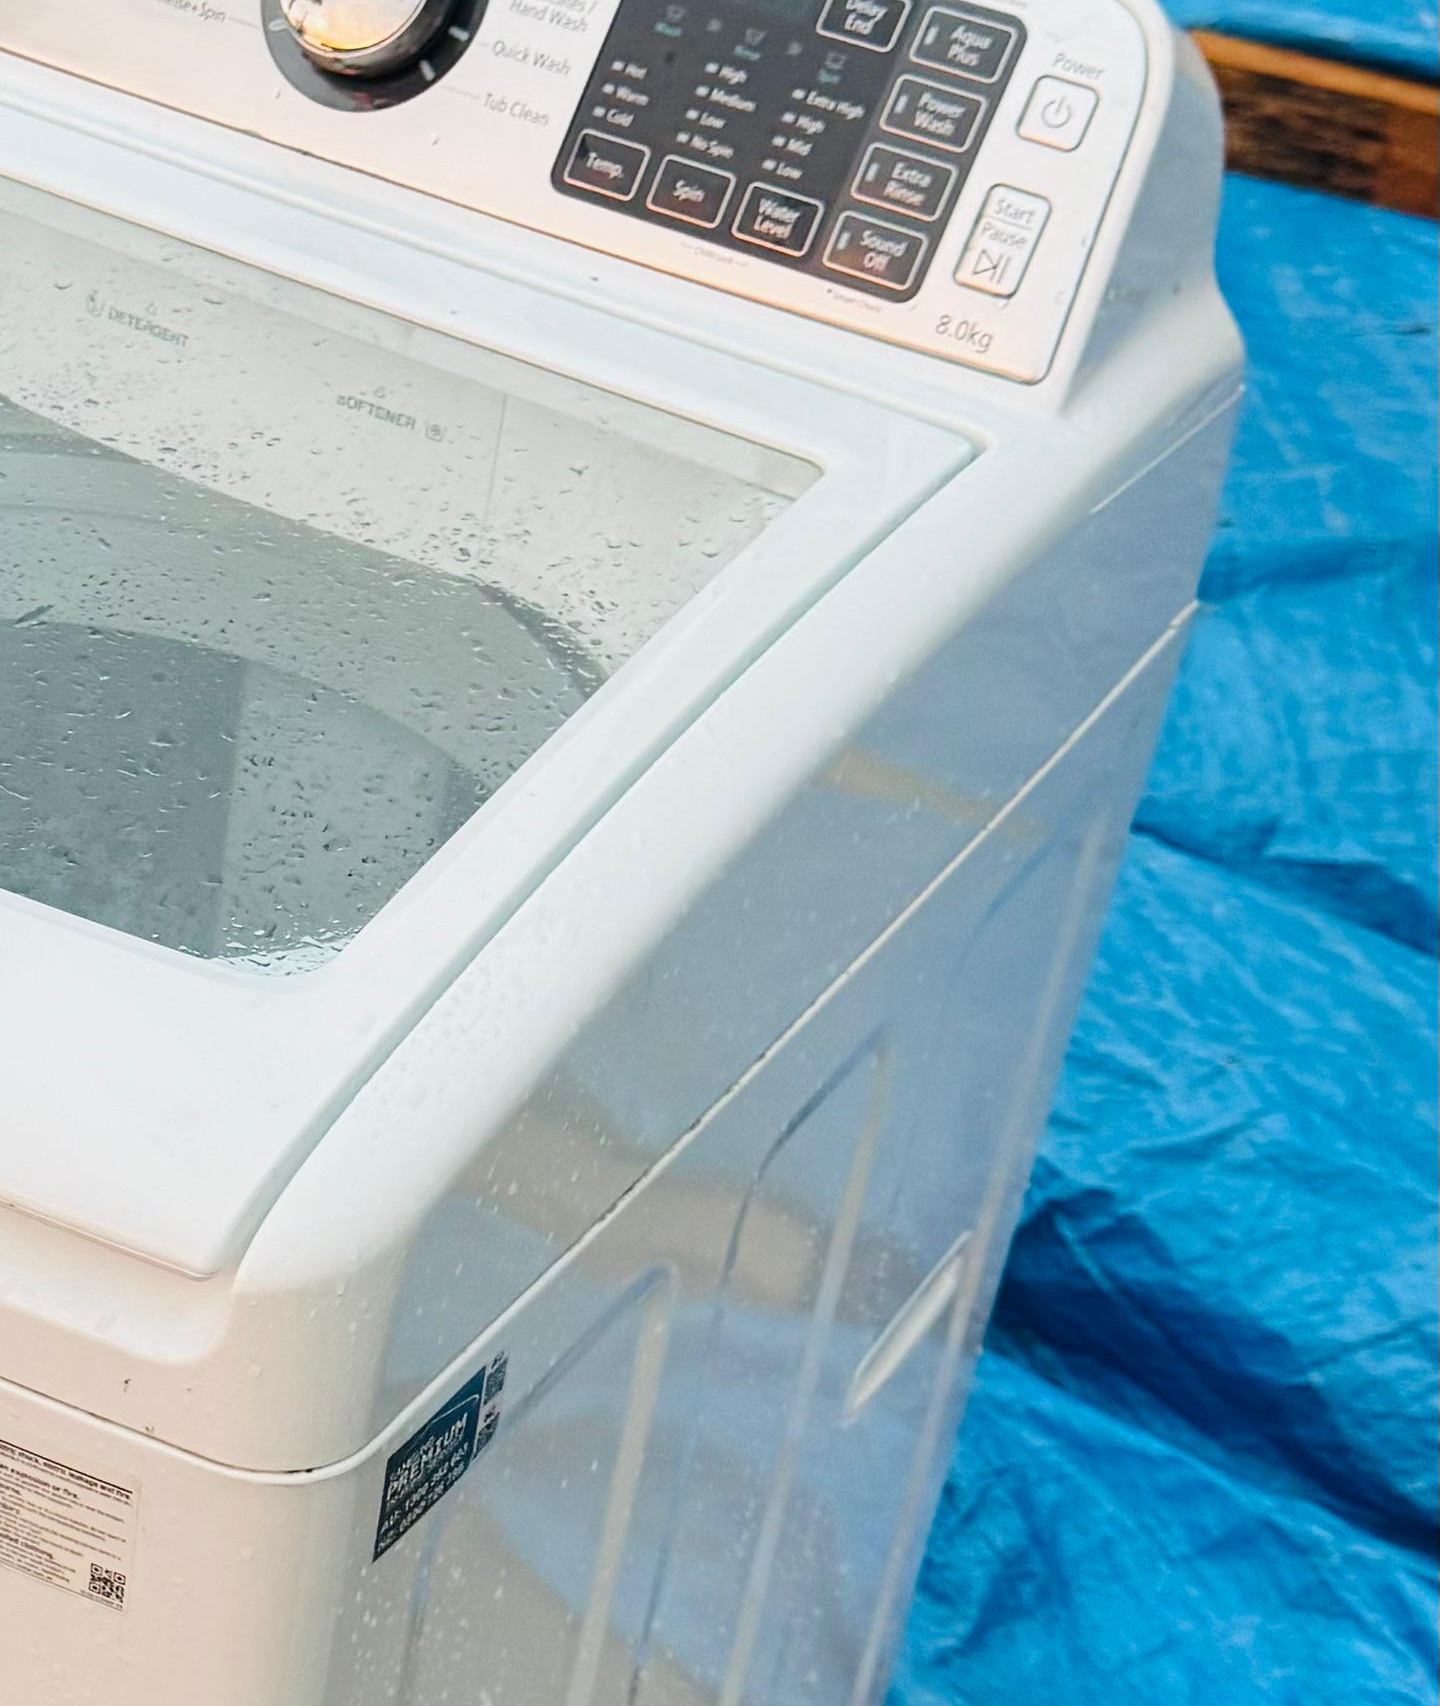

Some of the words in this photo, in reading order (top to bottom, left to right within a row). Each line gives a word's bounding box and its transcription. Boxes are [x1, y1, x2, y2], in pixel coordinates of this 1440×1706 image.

[549, 8, 589, 33] Wash
[844, 13, 875, 35] End
[950, 25, 994, 50] Aqua
[492, 40, 531, 64] Quick
[532, 54, 571, 77] Wash
[947, 43, 981, 67] Plus
[1052, 52, 1104, 81] Power
[483, 92, 509, 114] Tub
[509, 103, 550, 126] Clean
[917, 92, 966, 119] Power
[914, 110, 957, 137] Wash
[586, 152, 625, 180] Temp.
[891, 161, 933, 188] Extra
[672, 179, 706, 203] Spin
[883, 180, 925, 207] Rinse
[758, 197, 802, 224] Water
[993, 198, 1036, 225] Start
[753, 214, 794, 240] Level
[980, 222, 1028, 250] Pause
[860, 230, 909, 257] Sound
[863, 251, 892, 271] Off
[108, 306, 190, 348] DETERGENT
[935, 315, 995, 354] 8.0kg
[336, 394, 417, 430] SOFTENER
